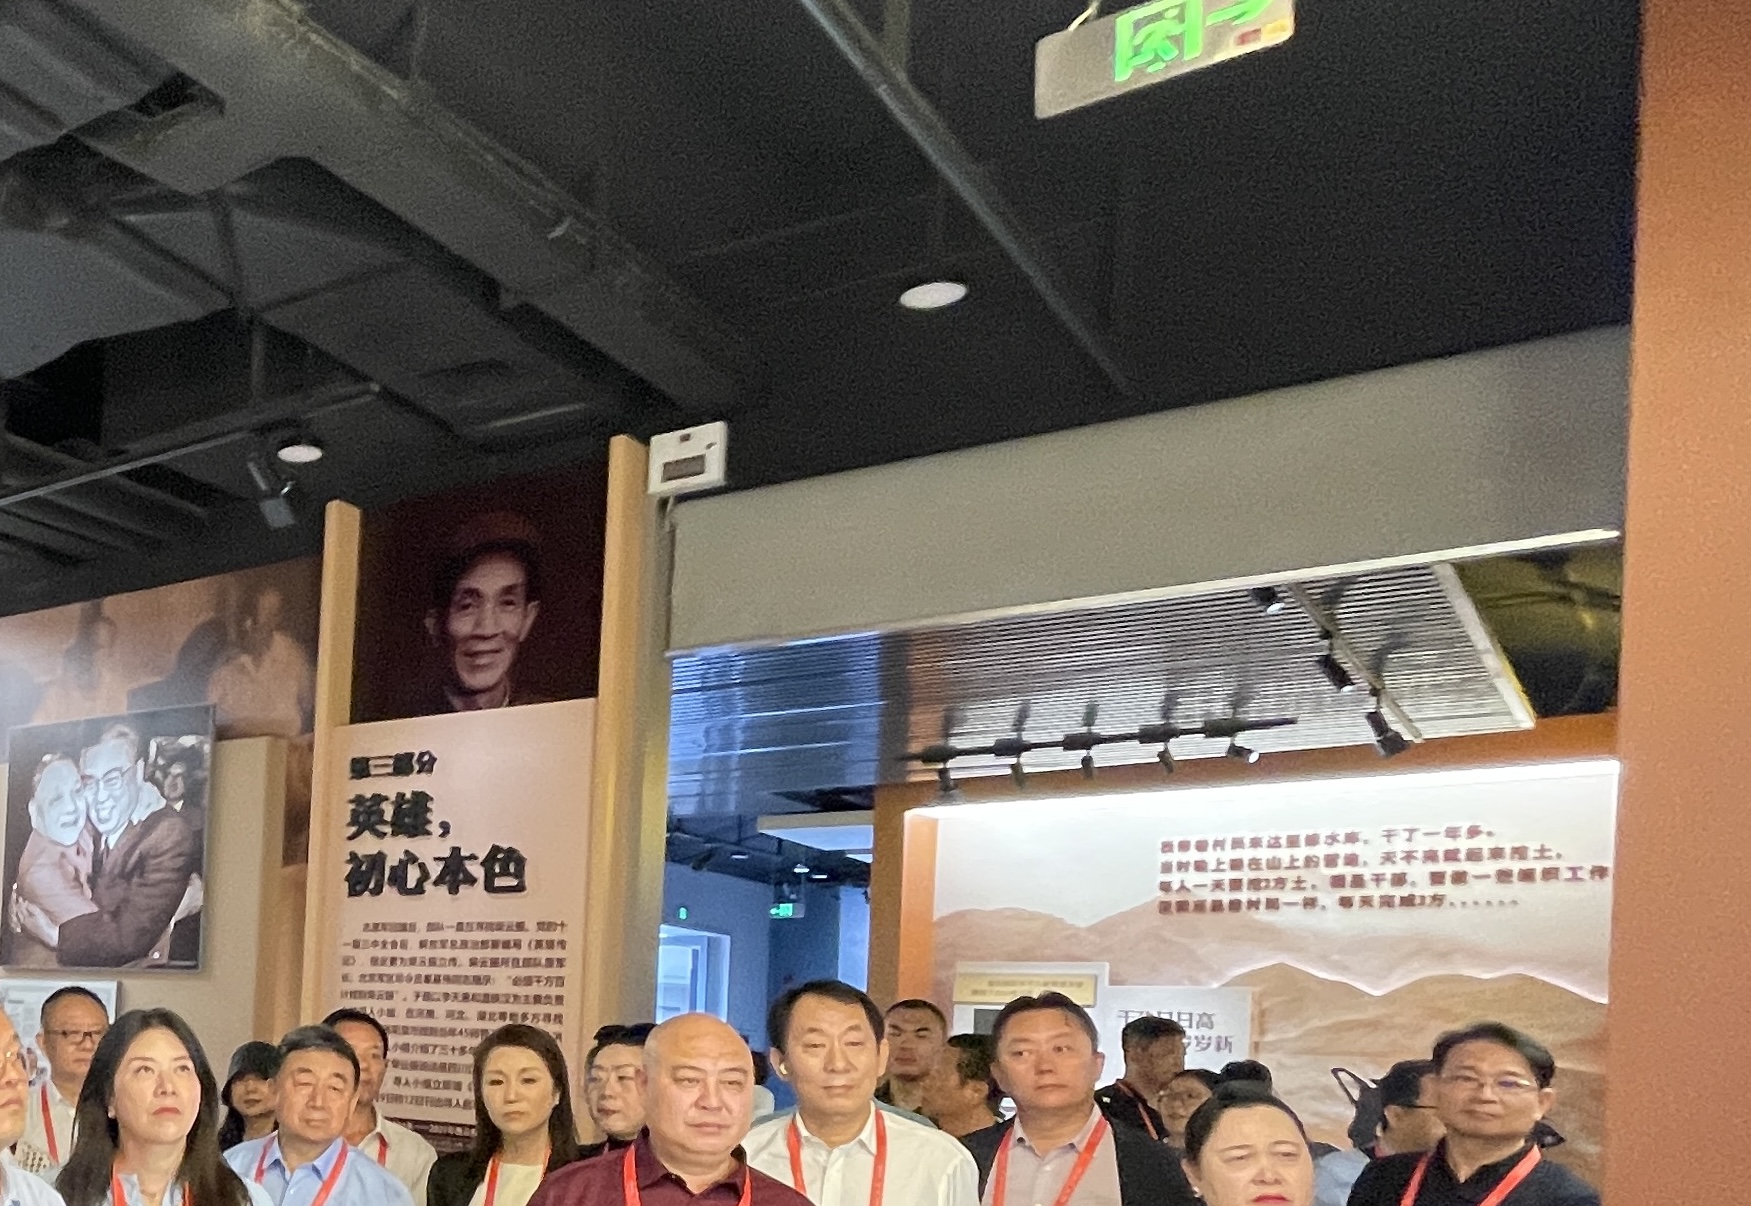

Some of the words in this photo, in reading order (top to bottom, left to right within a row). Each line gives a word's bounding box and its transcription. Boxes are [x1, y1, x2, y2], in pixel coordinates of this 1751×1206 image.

[349, 750, 437, 780] 第三部分
[346, 790, 452, 840] 英雄，
[344, 844, 527, 897] 初心本色
